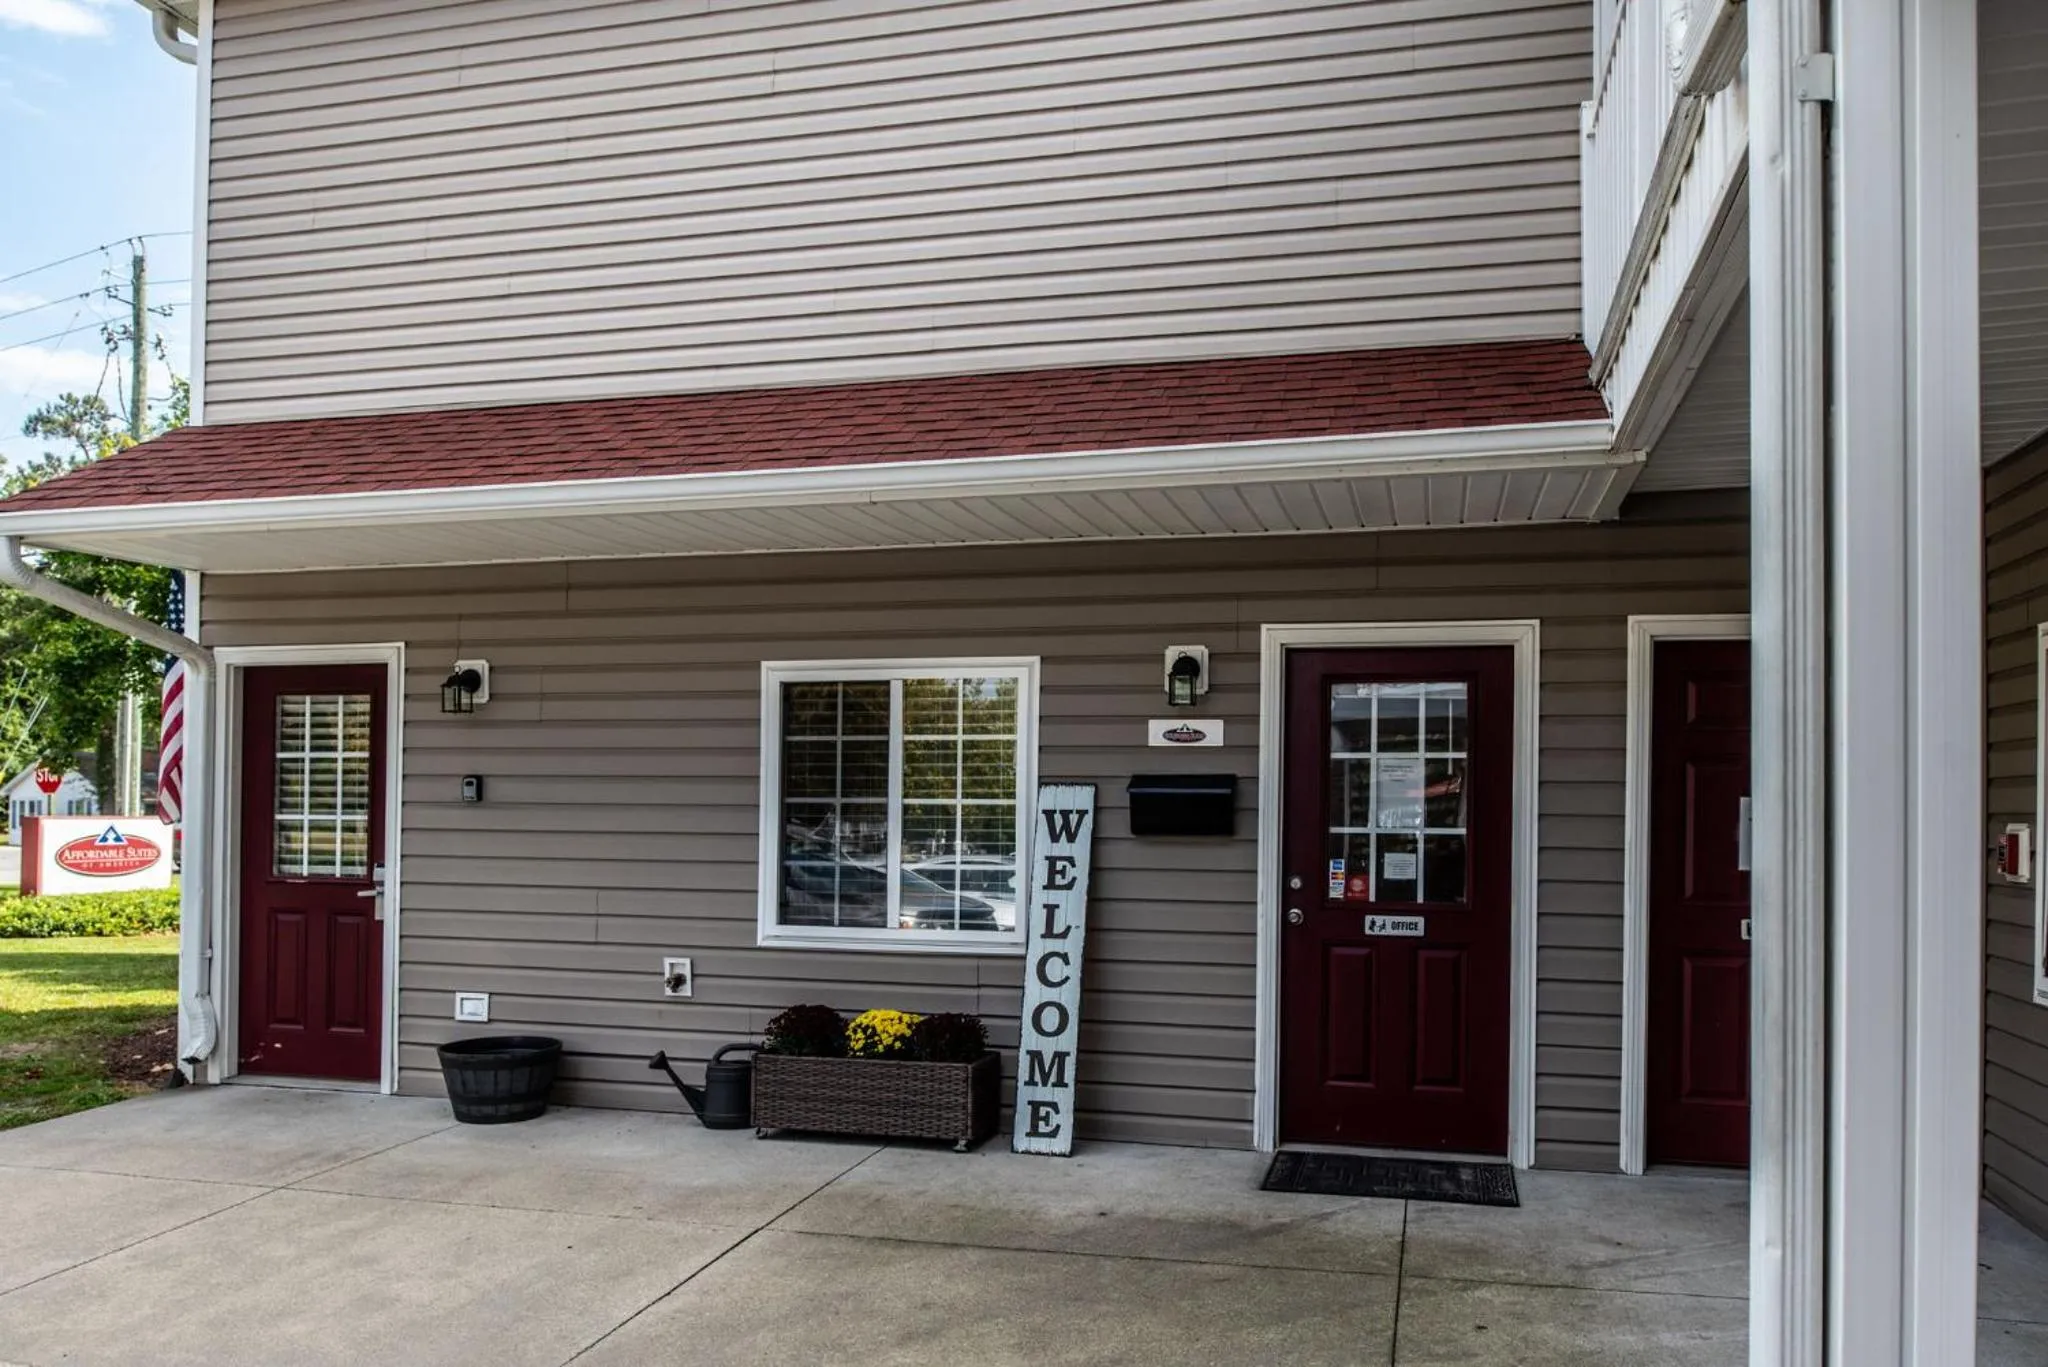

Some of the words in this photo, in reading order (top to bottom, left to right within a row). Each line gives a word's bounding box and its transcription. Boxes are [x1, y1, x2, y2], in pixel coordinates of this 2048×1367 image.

[62, 847, 125, 860] AFFORDABLE
[126, 846, 158, 858] SUITES
[1390, 920, 1419, 931] OFFICE
[1023, 808, 1089, 1139] WELCOME
